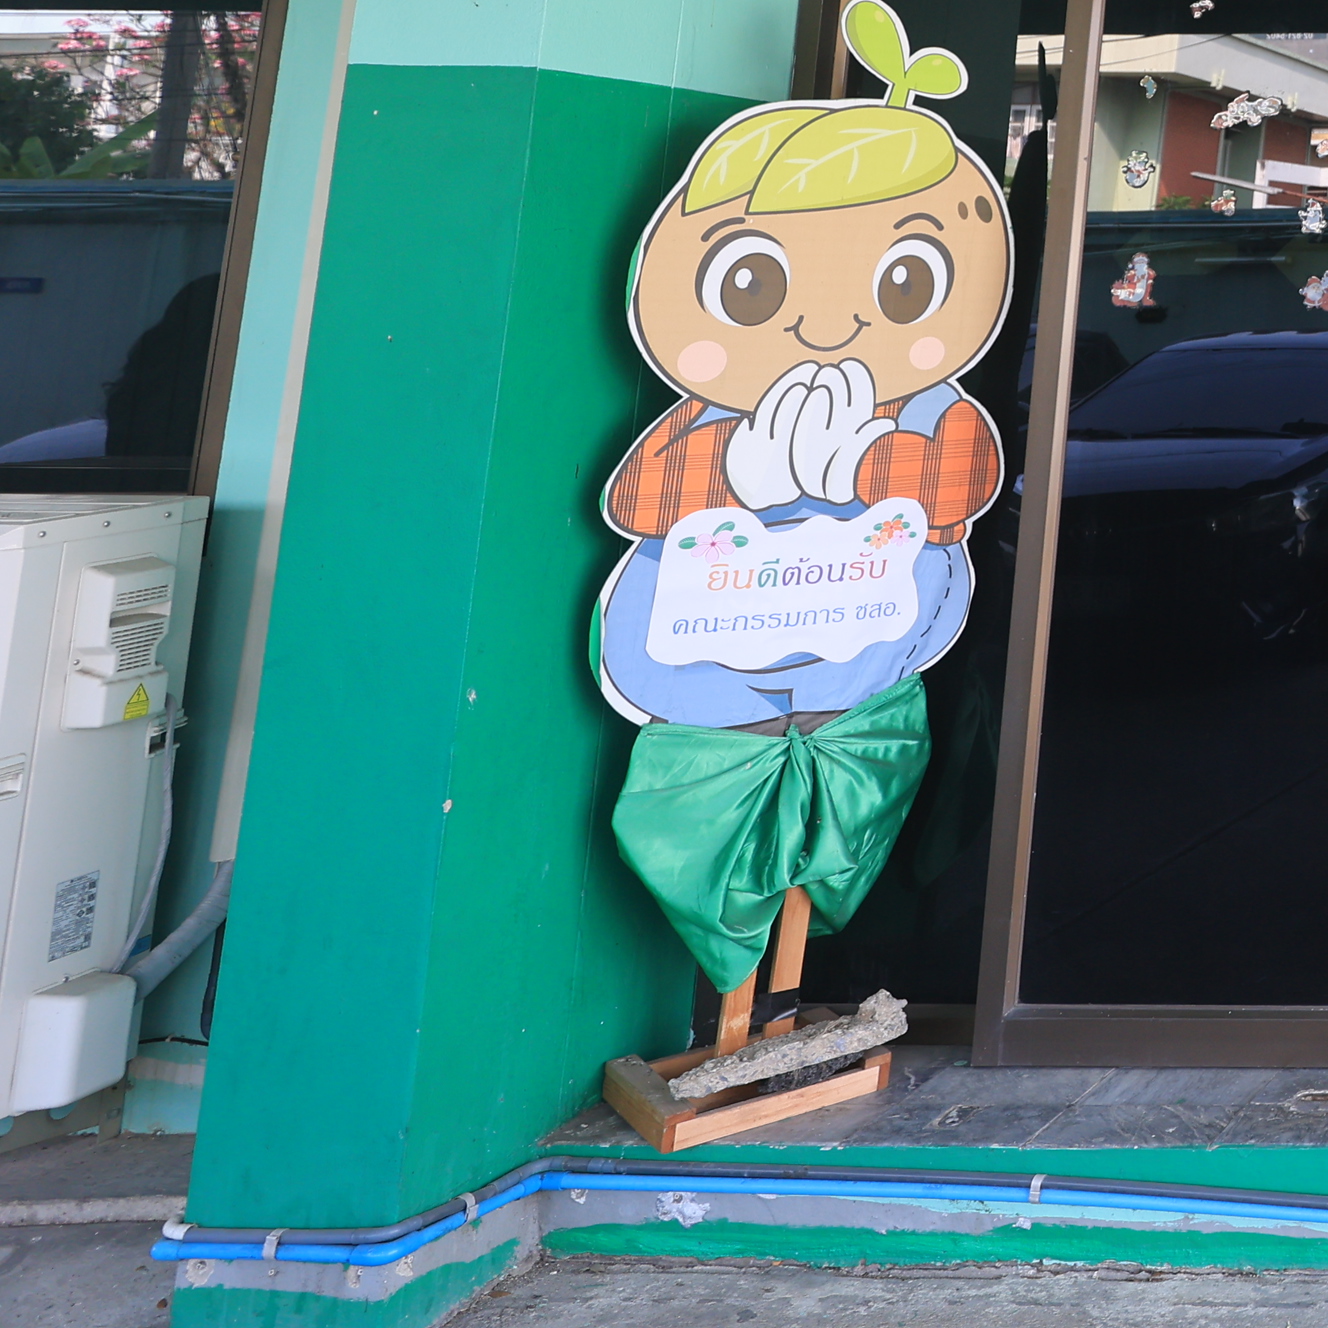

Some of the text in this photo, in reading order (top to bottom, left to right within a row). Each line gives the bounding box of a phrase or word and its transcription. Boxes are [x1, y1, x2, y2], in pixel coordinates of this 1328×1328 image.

[706, 552, 888, 591] ยินดีต้อนรับ
[672, 599, 901, 635] คณะกรรมการ ชสอ.
